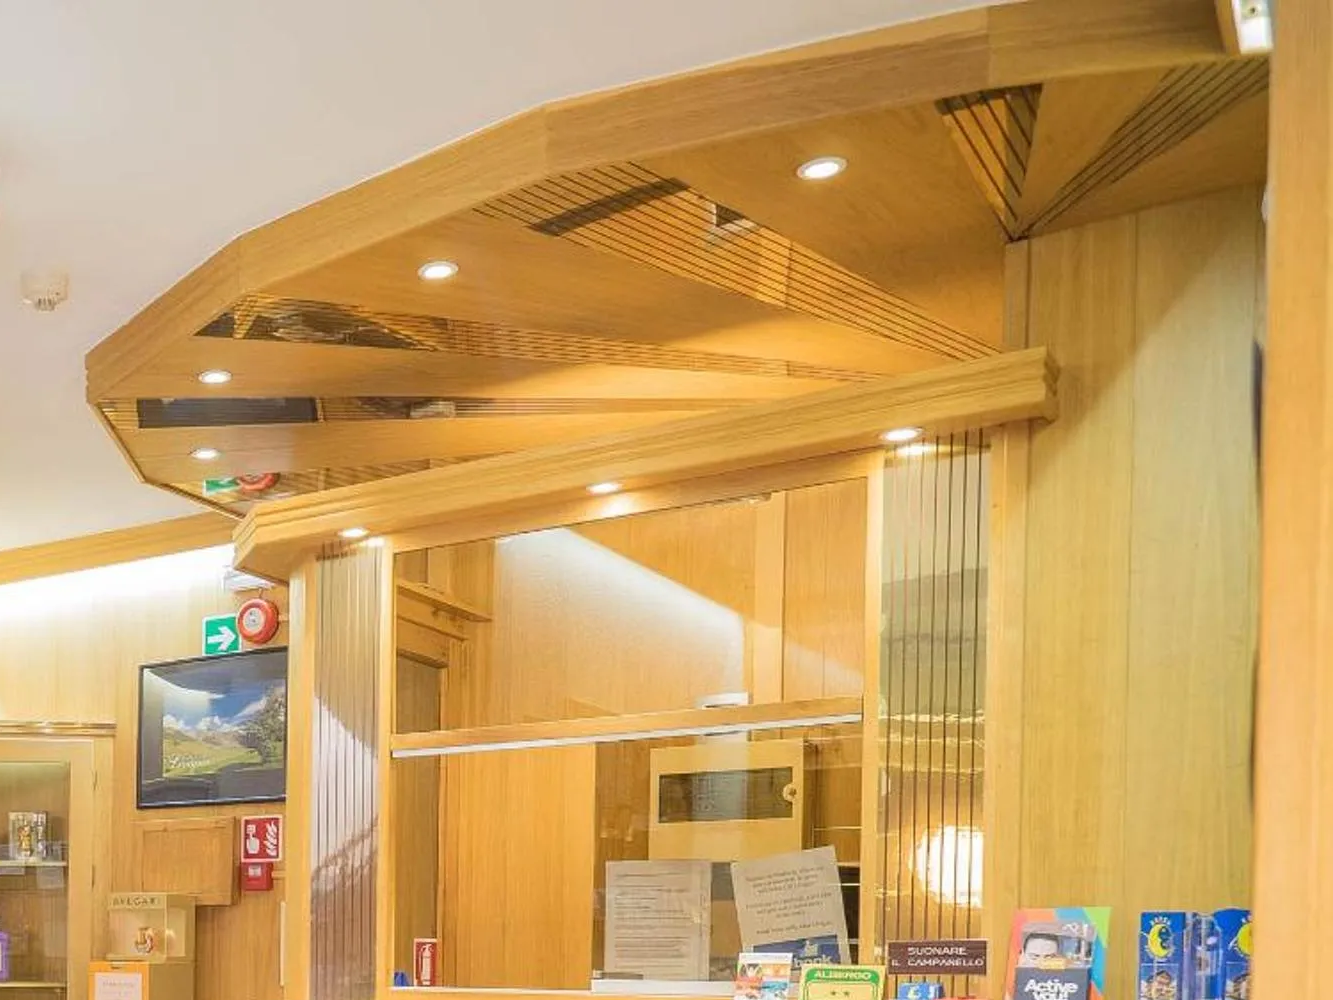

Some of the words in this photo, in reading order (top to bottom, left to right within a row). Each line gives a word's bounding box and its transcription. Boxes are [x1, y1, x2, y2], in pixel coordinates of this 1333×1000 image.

[907, 946, 968, 956] SUONARE
[891, 958, 902, 967] IL
[907, 958, 985, 967] CAMPANELLO
[813, 969, 873, 981] ALBERGO
[1024, 979, 1079, 994] Active
